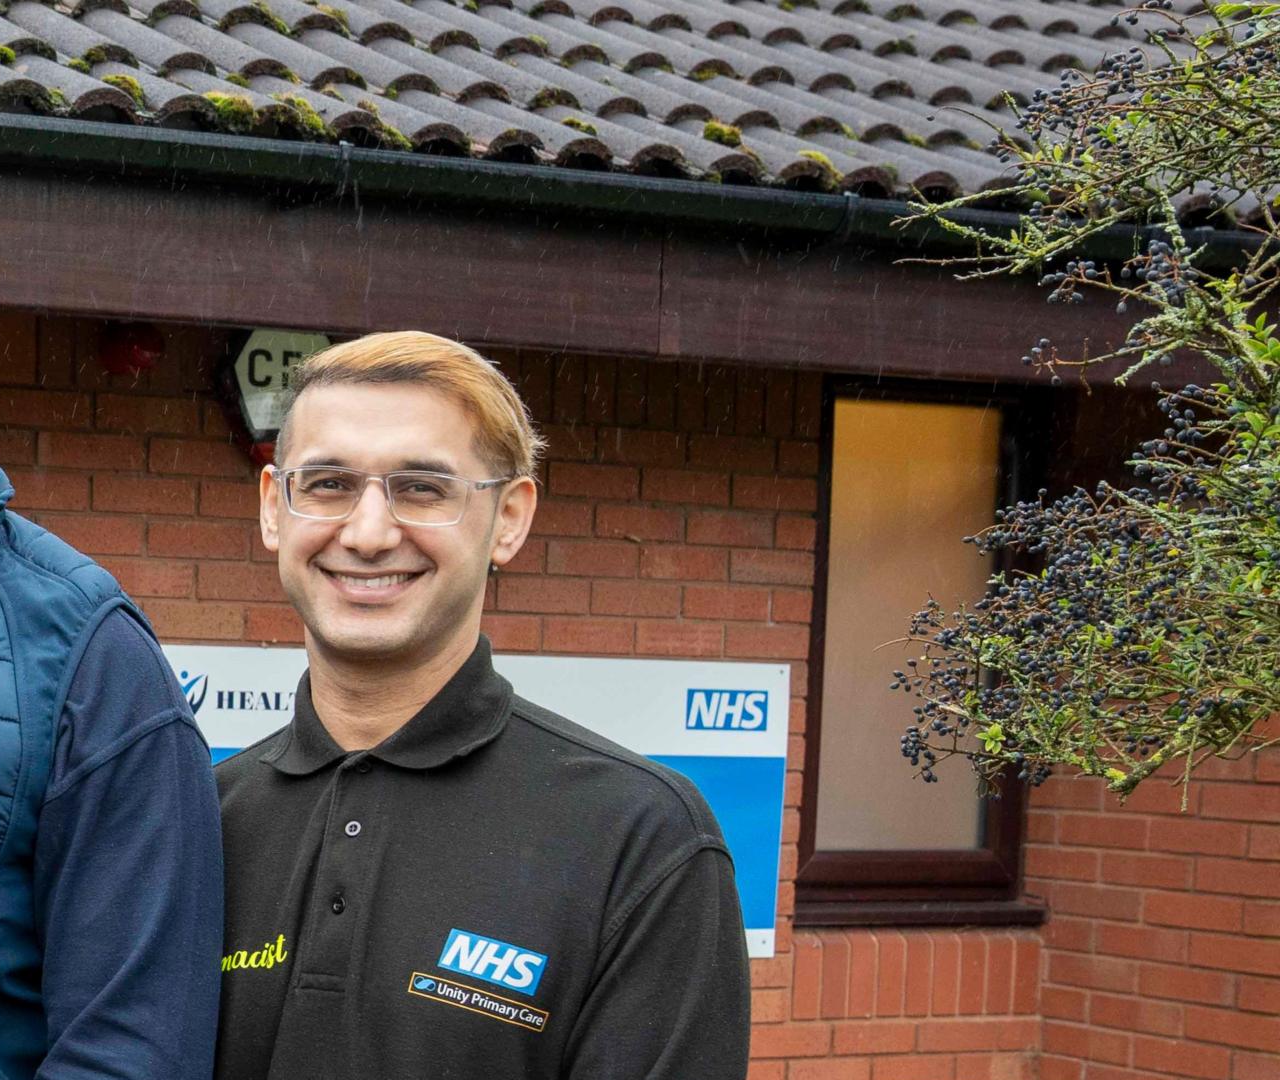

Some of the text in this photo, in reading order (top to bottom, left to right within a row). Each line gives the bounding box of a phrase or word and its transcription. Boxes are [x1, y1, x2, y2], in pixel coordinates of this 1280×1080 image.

[687, 691, 766, 730] NHS
[441, 933, 543, 988] NHS
[436, 982, 544, 1026] Unity Primary Care
